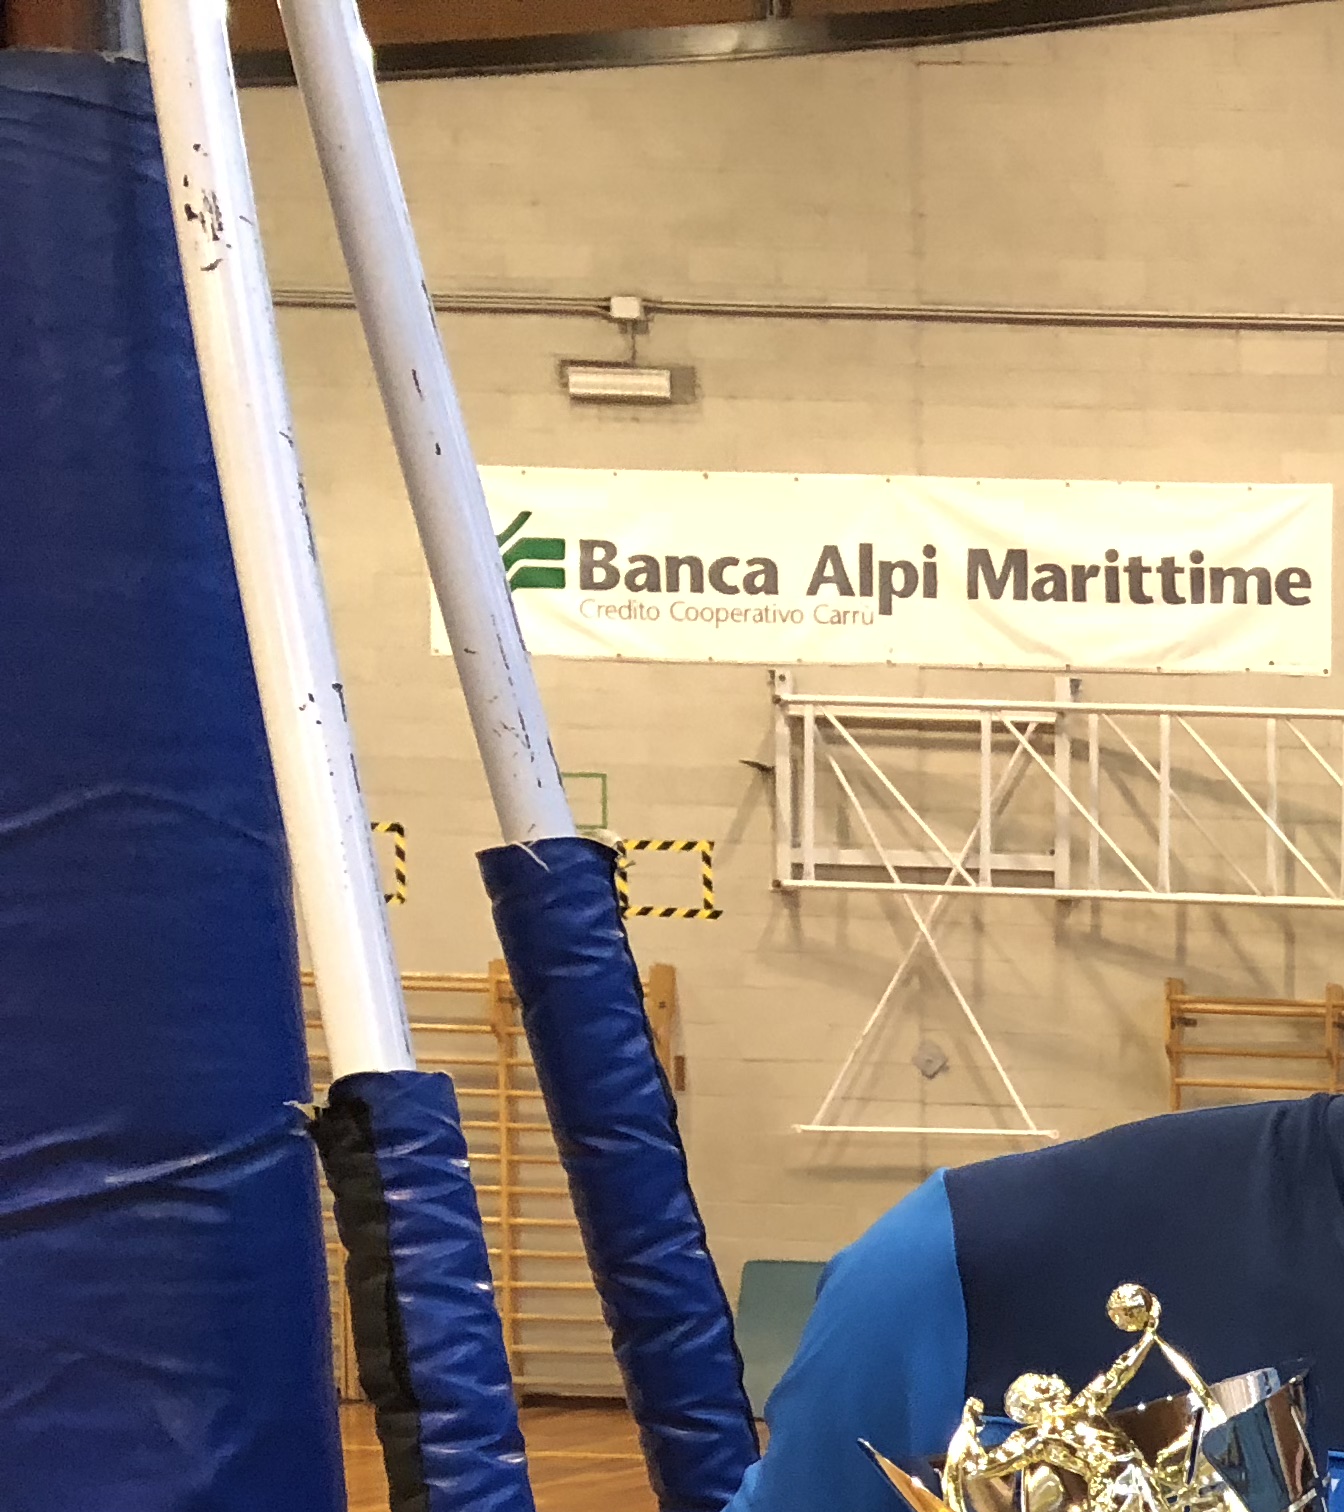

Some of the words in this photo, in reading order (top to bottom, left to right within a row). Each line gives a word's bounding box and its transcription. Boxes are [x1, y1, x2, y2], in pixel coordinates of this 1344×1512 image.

[579, 538, 779, 596] Banca
[806, 542, 938, 616] Alpi
[966, 547, 1312, 606] Marittime
[579, 598, 661, 622] Credito
[669, 601, 804, 628] Cooperativo
